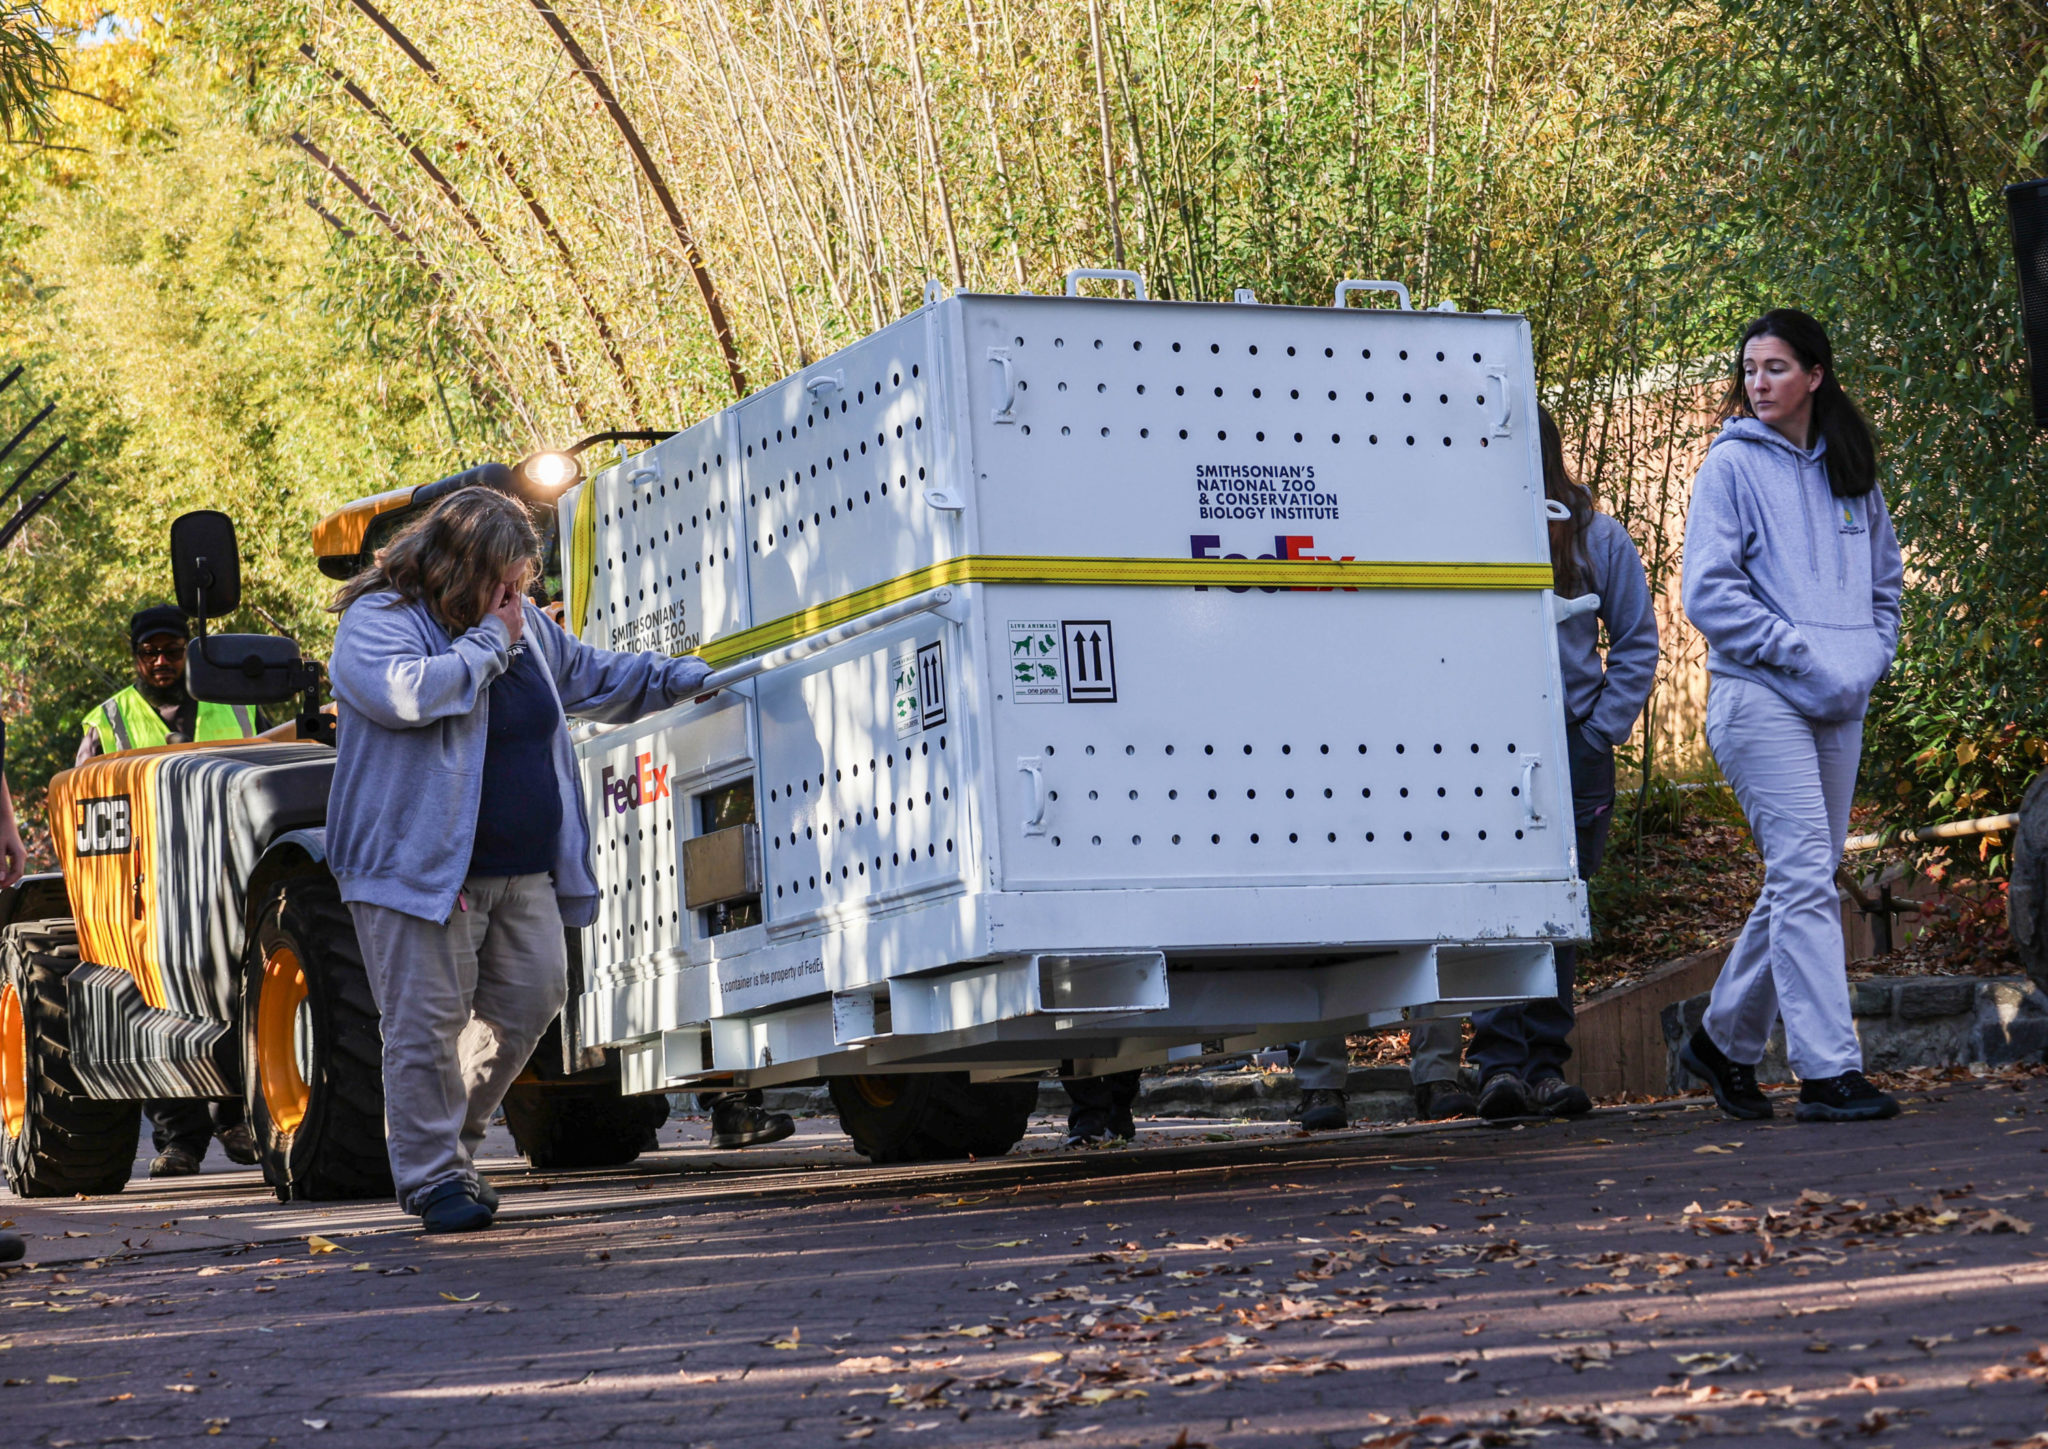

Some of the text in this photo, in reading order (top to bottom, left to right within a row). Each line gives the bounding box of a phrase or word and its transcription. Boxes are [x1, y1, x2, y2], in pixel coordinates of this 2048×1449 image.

[1196, 465, 1314, 478] SMITHSONIAN'S
[1197, 479, 1316, 491] NATIONAL ZOO
[1199, 493, 1338, 506] & CONSERVATION
[1200, 507, 1339, 520] BIOLOGY INSTITUTE
[1190, 535, 1359, 593] FdE
[612, 599, 685, 645] SMITHSONIAN'S
[613, 619, 686, 654] ATIONAL ZOO
[1040, 687, 1059, 695] panda
[602, 752, 670, 818] FedEx
[77, 800, 131, 852] JCB
[725, 975, 752, 992] container
[753, 972, 759, 986] is
[760, 970, 770, 985] the
[771, 966, 796, 986] property
[797, 961, 804, 977] of
